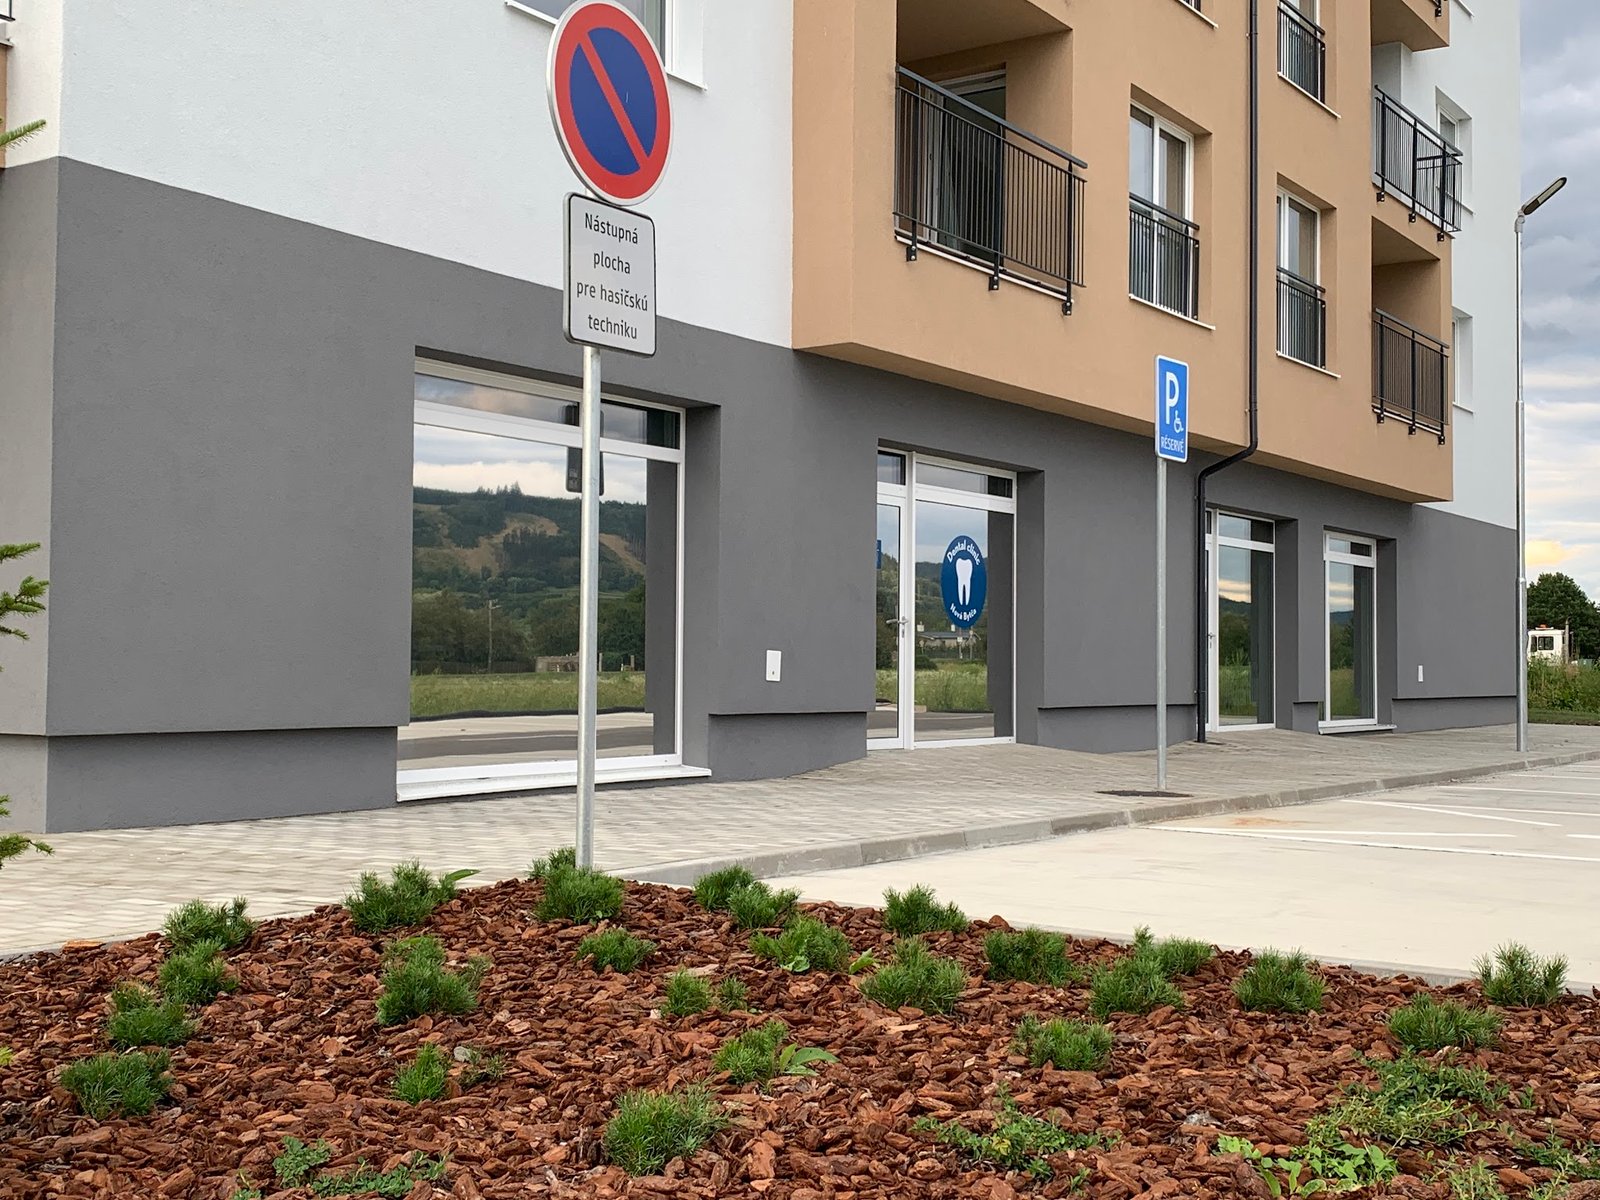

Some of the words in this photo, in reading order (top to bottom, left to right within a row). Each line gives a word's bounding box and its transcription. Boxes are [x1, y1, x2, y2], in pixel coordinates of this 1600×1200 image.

[585, 212, 638, 244] Nástupná
[593, 251, 631, 274] plocha
[576, 281, 596, 298] pre
[600, 284, 648, 312] hasičskú
[587, 314, 637, 339] techniku
[1165, 371, 1179, 425] P
[1160, 434, 1184, 453] RÉSERVÉ
[946, 539, 967, 563] Dental
[966, 543, 981, 566] clinic
